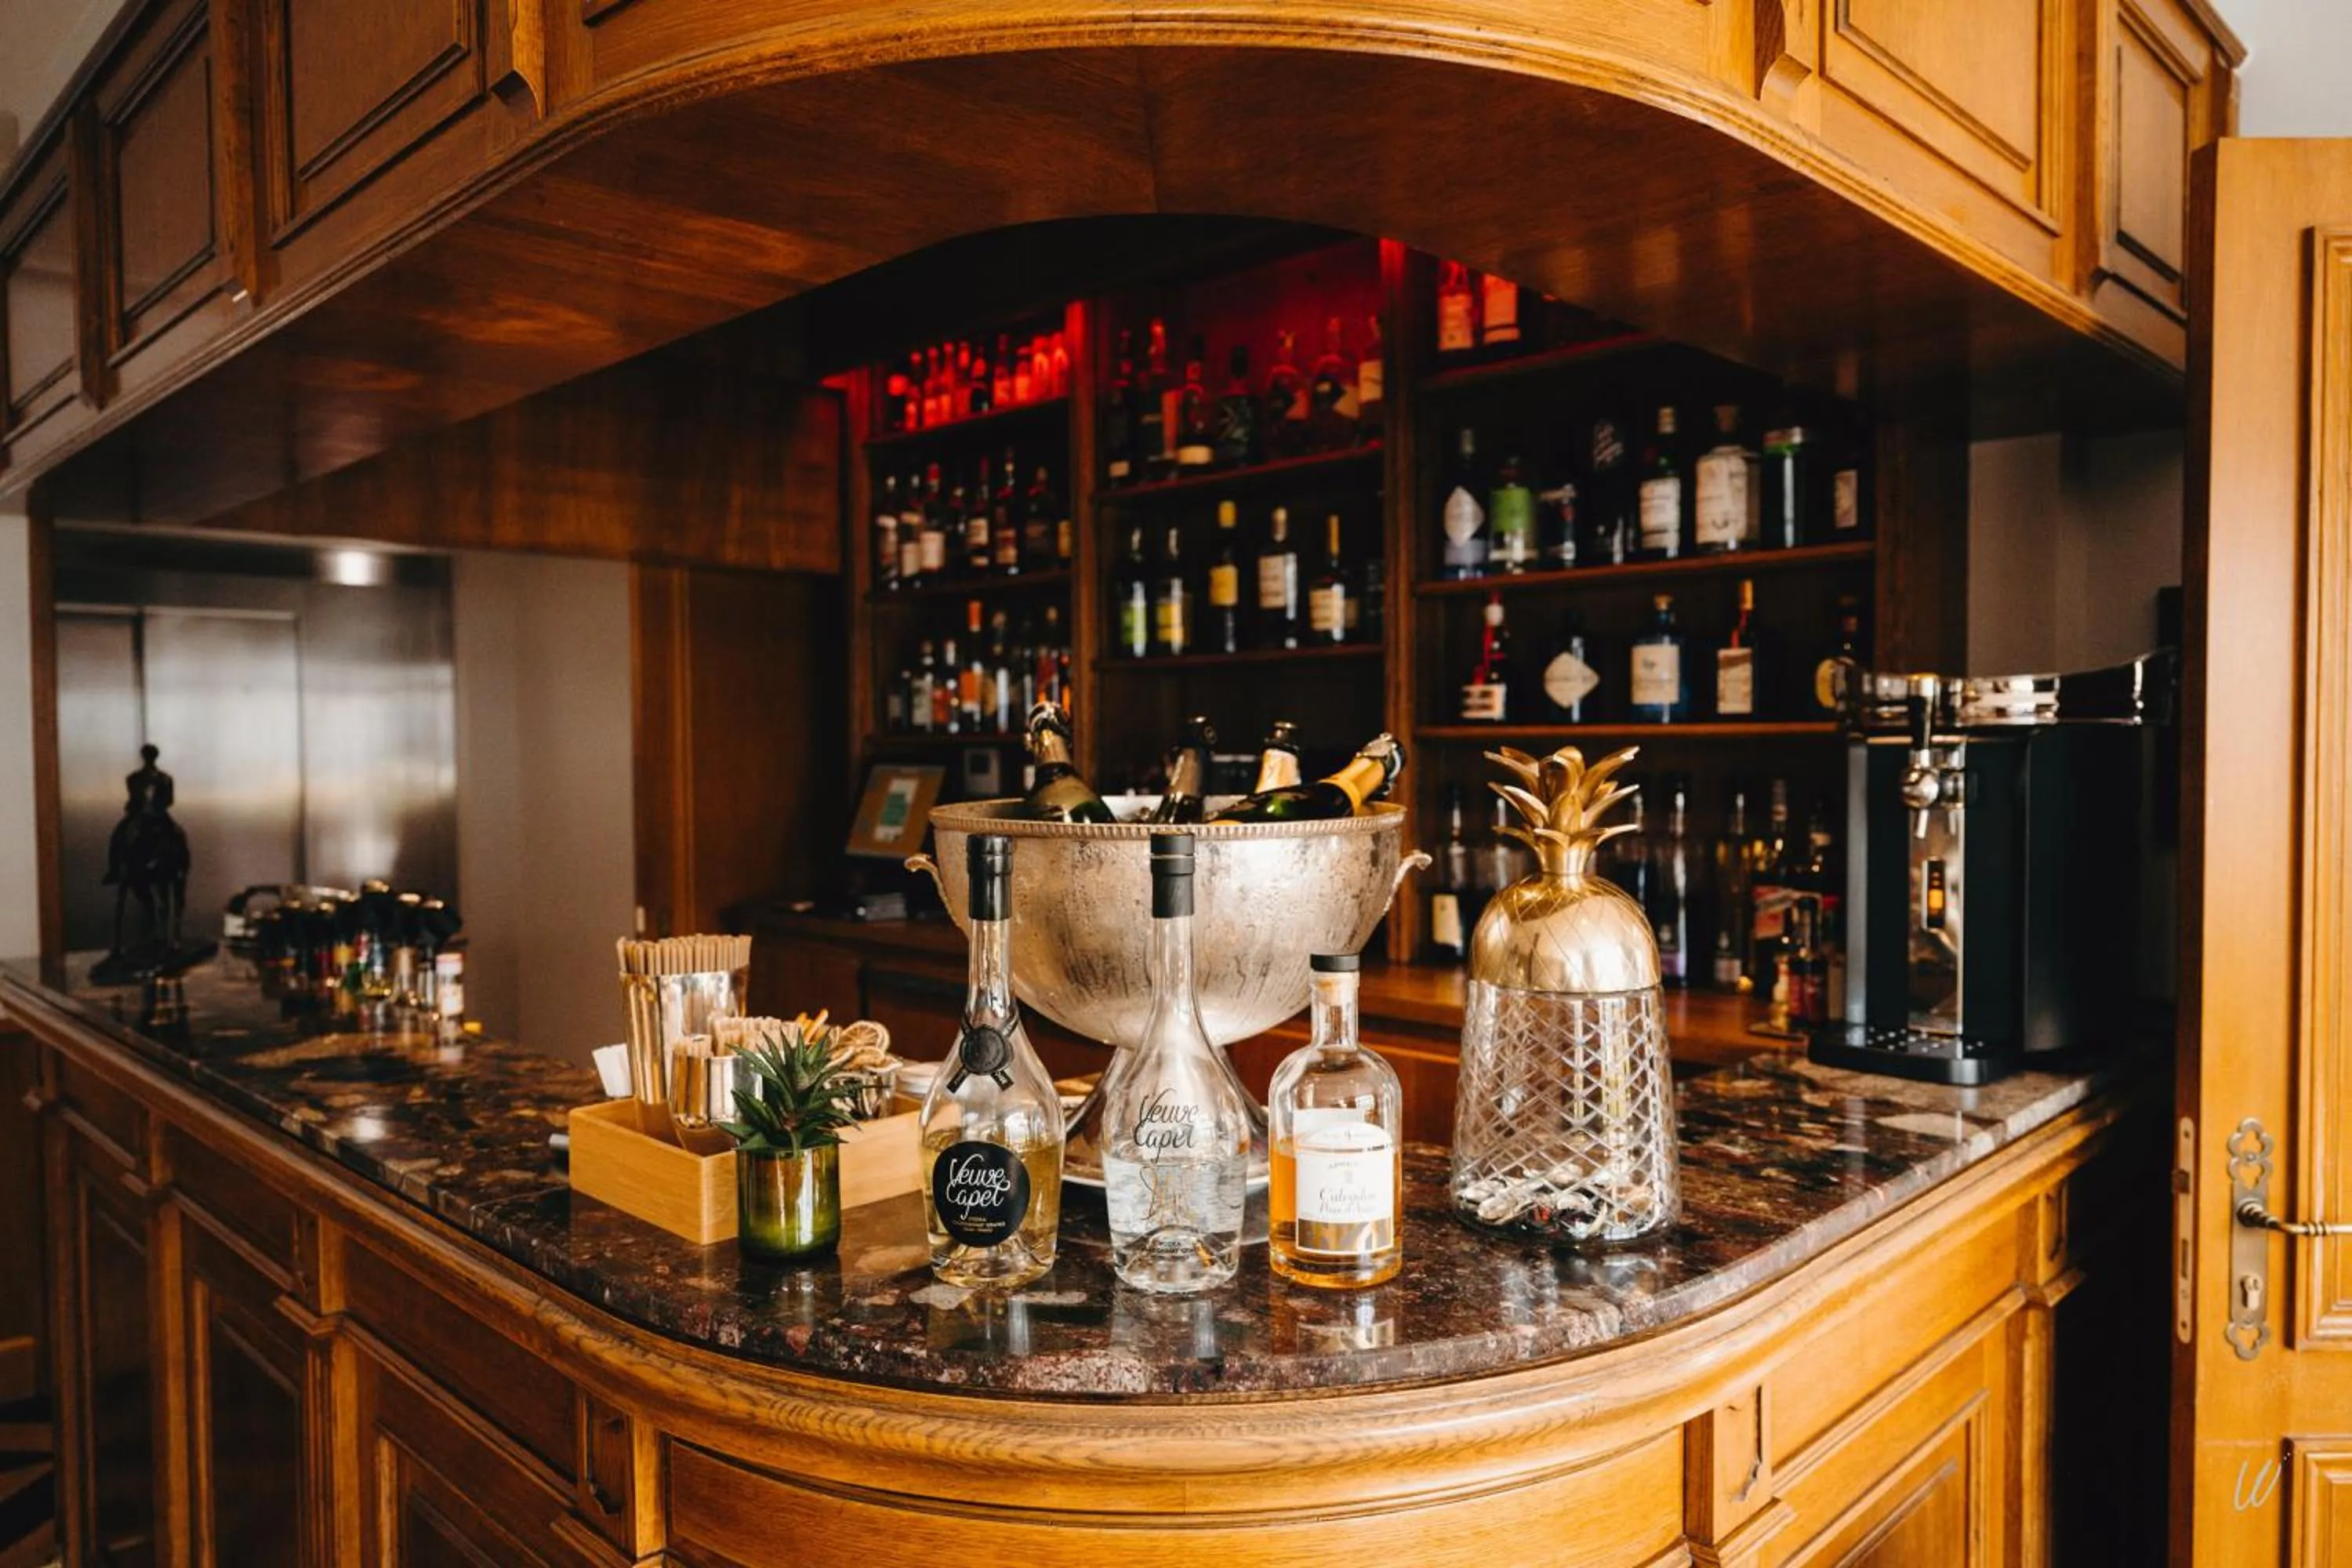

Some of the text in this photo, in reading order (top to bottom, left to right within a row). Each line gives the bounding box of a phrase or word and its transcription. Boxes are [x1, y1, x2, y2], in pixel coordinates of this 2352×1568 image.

[1139, 1087, 1199, 1127] Veuve
[1134, 1122, 1195, 1164] Capet
[949, 1153, 1007, 1187] Veuve
[946, 1181, 1011, 1220] Capet
